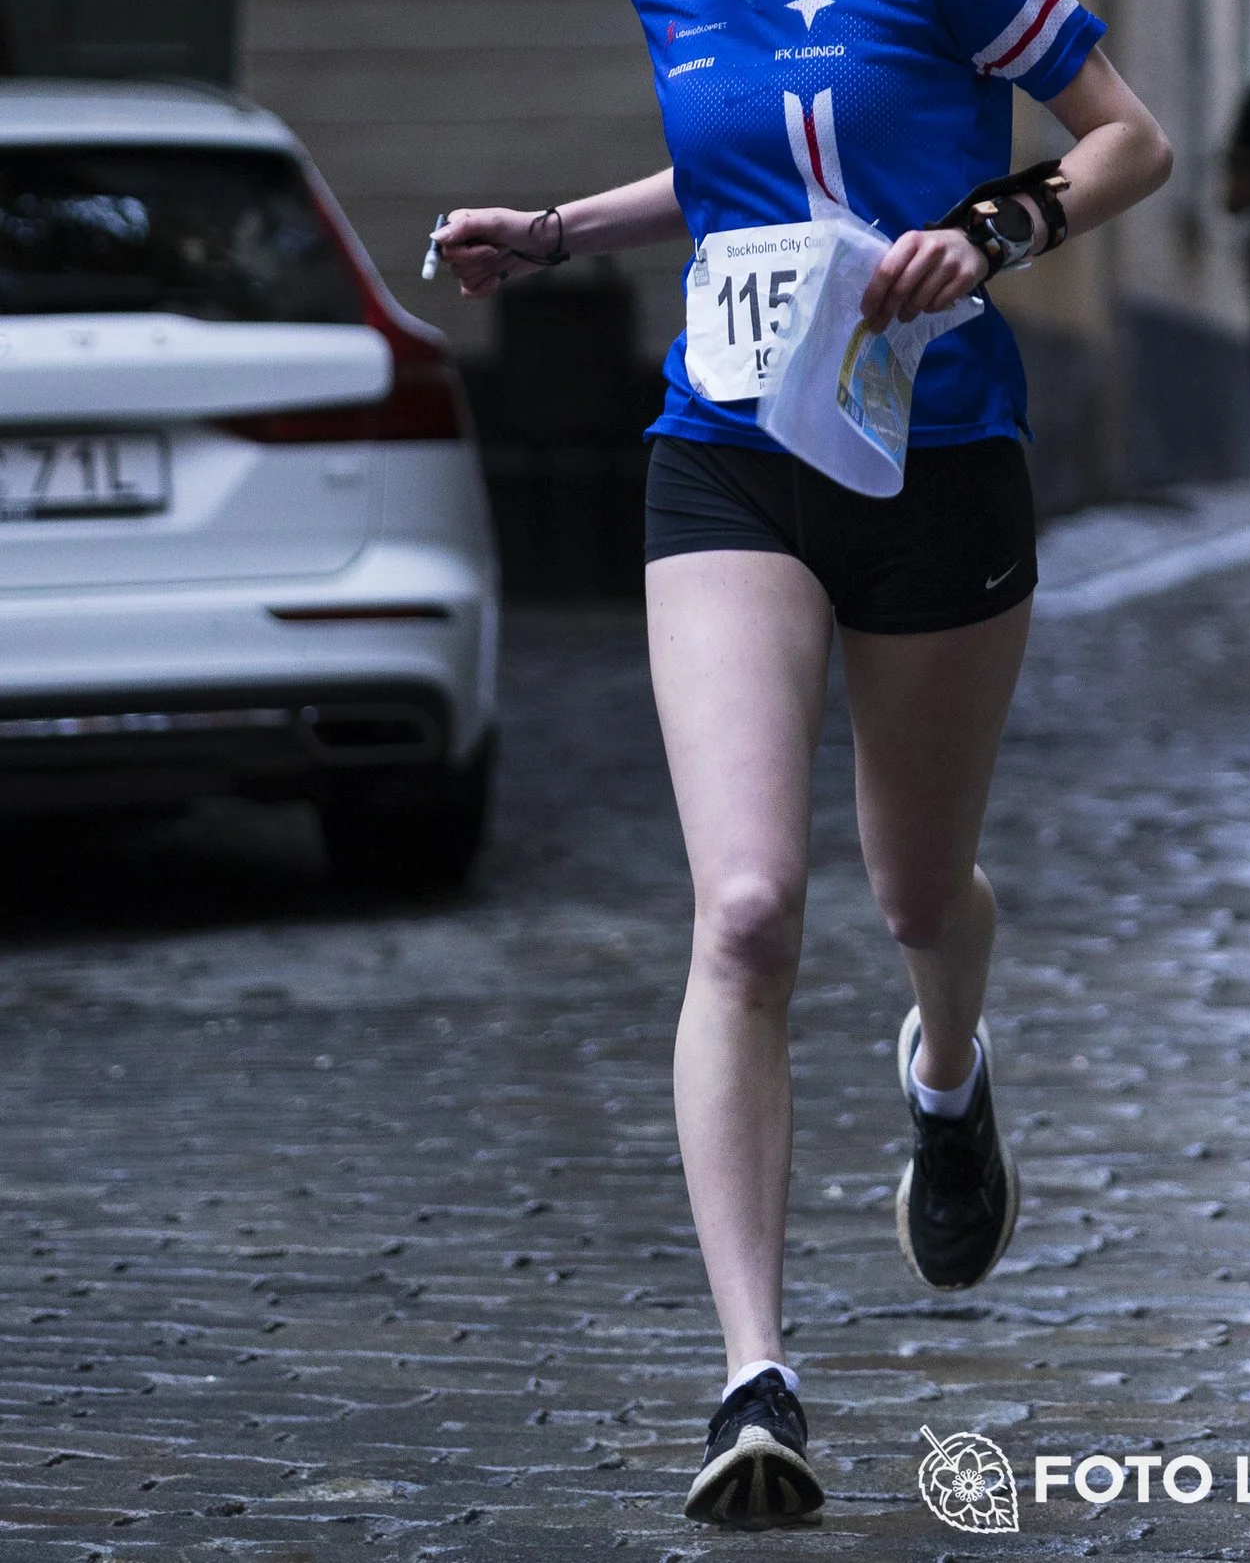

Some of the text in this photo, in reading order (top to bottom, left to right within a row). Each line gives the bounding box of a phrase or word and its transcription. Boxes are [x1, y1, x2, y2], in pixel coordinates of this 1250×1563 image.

[775, 43, 845, 61] IFK LIDINGÖ
[667, 56, 716, 79] noname
[727, 242, 777, 259] Stockholm
[780, 238, 801, 253] City
